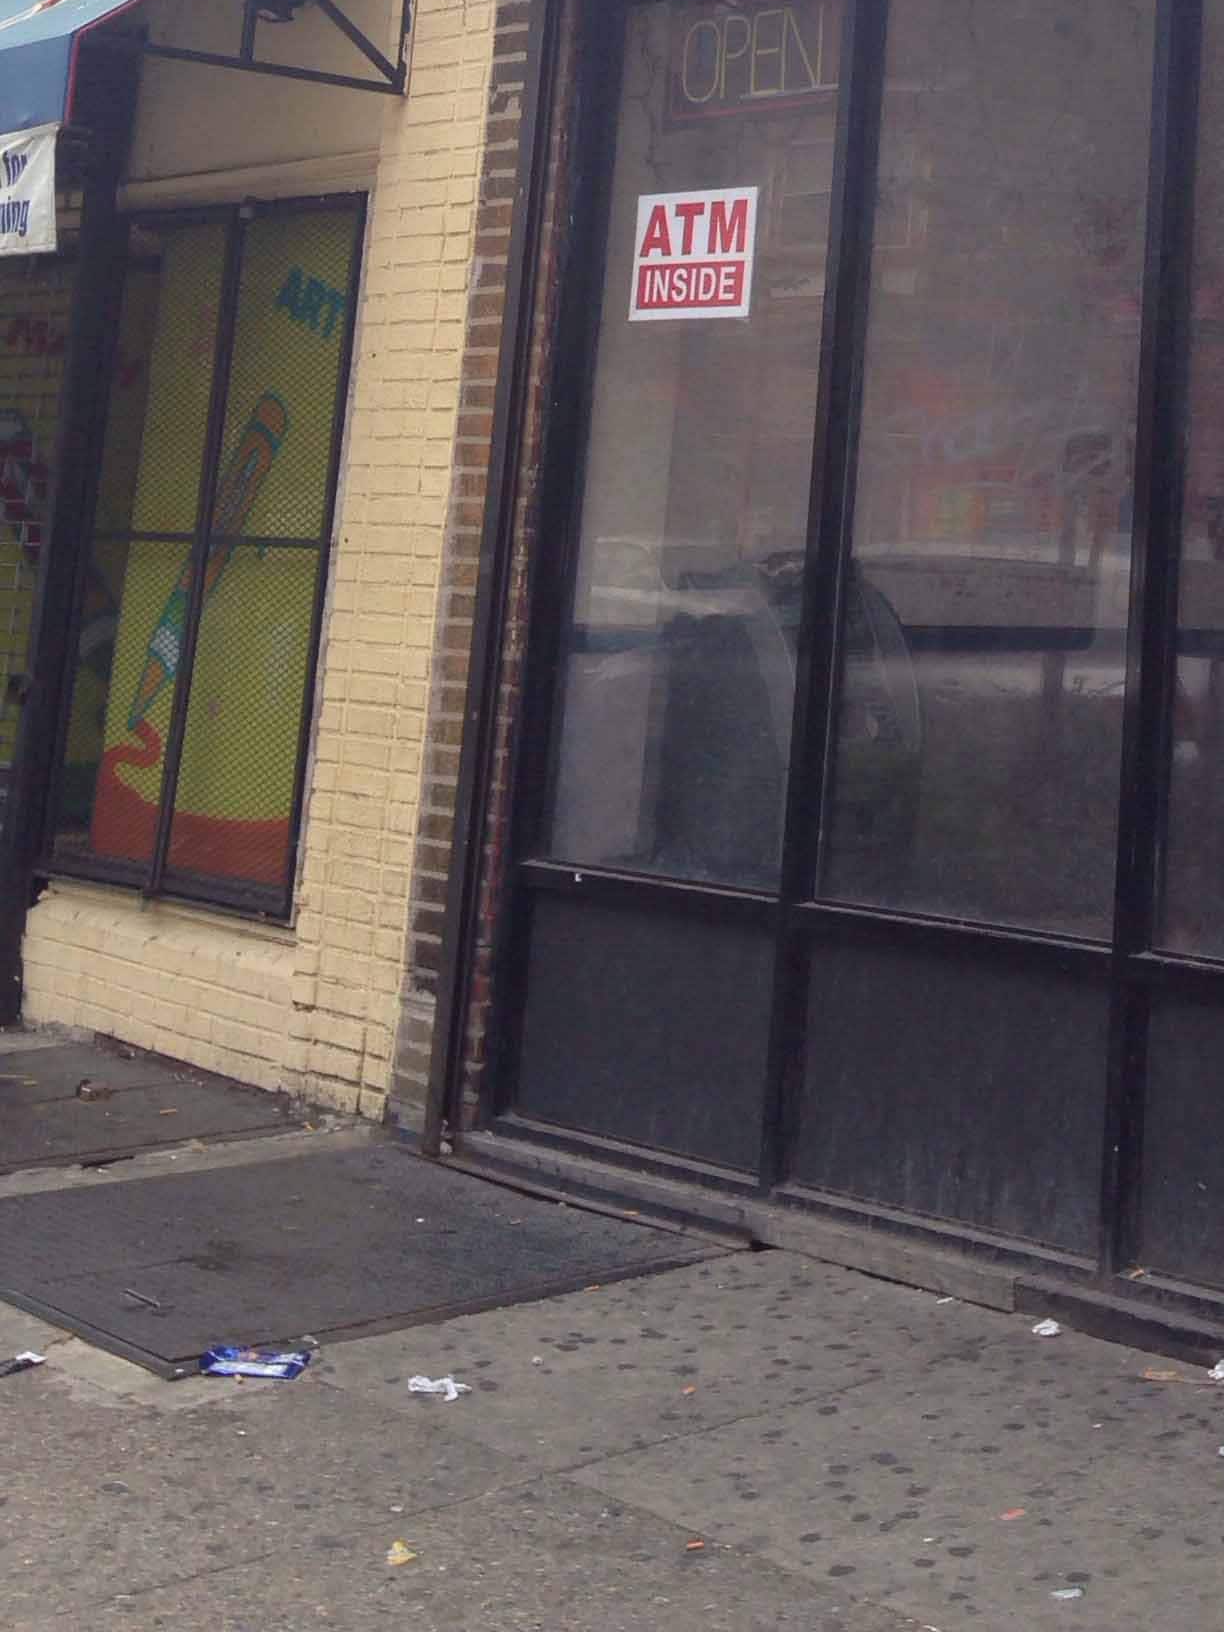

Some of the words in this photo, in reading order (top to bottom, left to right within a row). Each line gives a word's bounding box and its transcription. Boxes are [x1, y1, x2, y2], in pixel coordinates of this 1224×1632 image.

[682, 6, 824, 103] OPEN
[640, 199, 749, 258] ATM
[643, 265, 737, 304] INSIDE
